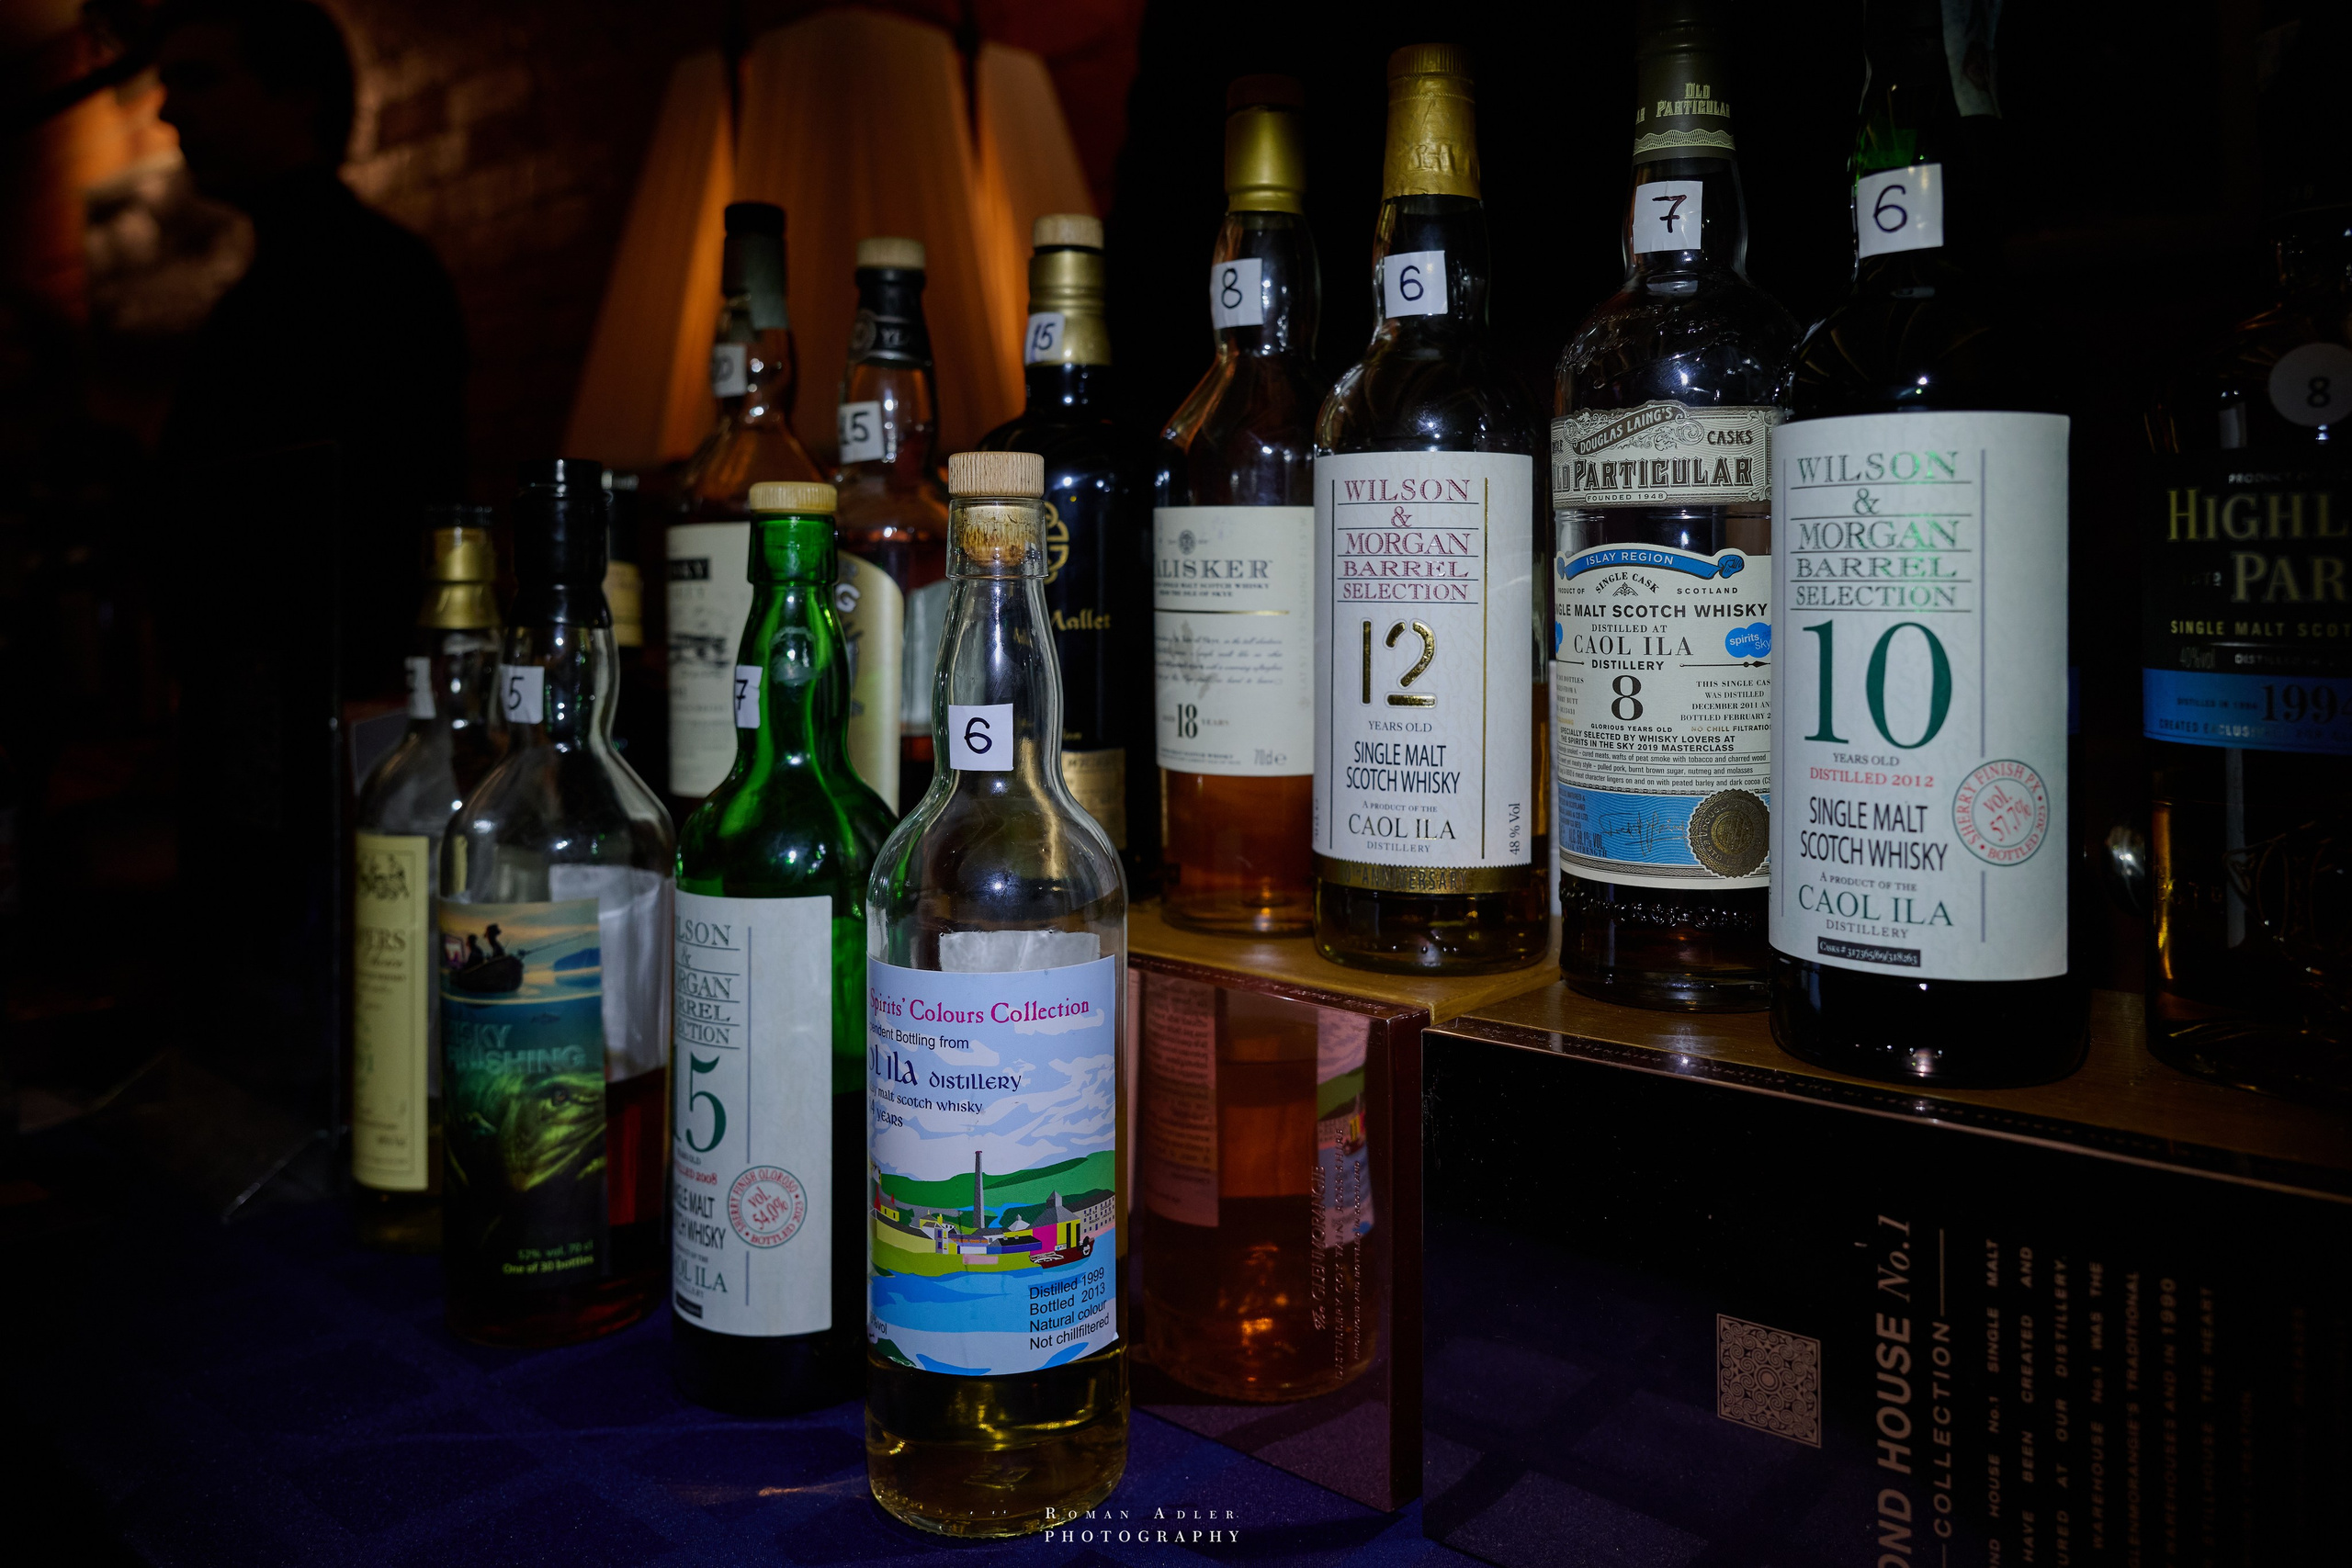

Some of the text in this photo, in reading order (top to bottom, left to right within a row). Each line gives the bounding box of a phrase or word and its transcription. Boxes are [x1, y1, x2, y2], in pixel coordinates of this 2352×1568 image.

[1684, 82, 1711, 99] OLD
[1656, 99, 1731, 118] PARTICULAR
[1652, 194, 1687, 233] 7
[1872, 185, 1907, 233] 6
[1221, 267, 1243, 309] 8
[1399, 265, 1423, 301] 6
[1032, 322, 1056, 350] 15
[2307, 377, 2329, 408] 8
[1579, 424, 1623, 455] DOUGLAS
[1626, 406, 1672, 434] LAING'S
[1707, 430, 1753, 446] CASKS
[1573, 456, 1754, 492] PARTICULAR
[1796, 451, 1959, 484] WILSON
[1344, 479, 1470, 502] WILSON
[1852, 488, 1880, 515] &
[1390, 506, 1412, 528] &
[2165, 486, 2349, 543] HIGHL
[1345, 532, 1471, 555] MORGAN
[1798, 520, 1960, 550] MORGAN
[1343, 560, 1469, 578] BARREL
[1586, 552, 1674, 566] ISLAY REGION
[1796, 557, 1958, 578] BARREL
[1595, 571, 1660, 594] SINGLE CASK
[2230, 551, 2348, 604] PAR
[1342, 582, 1468, 601] SELECTION
[1795, 585, 1957, 607] SELECTION
[1574, 603, 1768, 618] MALT SCOTCH WHISKY
[1591, 624, 1647, 633] DISTILLED
[1729, 633, 1759, 647] spirits
[2170, 619, 2286, 637] SINGLE MALT
[1574, 635, 1693, 656] CAOL ILA
[1363, 620, 1436, 706] 12
[1591, 660, 1665, 671] DISTILLERY
[509, 676, 525, 710] 5
[736, 680, 749, 711] 7
[1611, 674, 1644, 721] 8
[1803, 619, 1952, 750] 10
[1680, 713, 1765, 722] BOTTLED FEBRUARY
[1691, 702, 1738, 710] DECEMBER
[964, 716, 992, 754] 6
[1177, 704, 1197, 739] 18
[1368, 720, 1432, 733] YEARS OLD
[1568, 737, 1588, 746] SPIRITS
[1584, 731, 1623, 740] SELECTED
[1639, 735, 1678, 743] WHISKY
[1354, 740, 1446, 767] SINGLE MALT
[1635, 755, 1648, 763] peat
[1728, 754, 1750, 762] charred
[1832, 752, 1900, 767] YEARS OLD
[1346, 767, 1460, 794] SCOTCH WHISKY
[1810, 767, 1935, 788] DISTILLED 2012
[1809, 795, 1928, 833] SINGLE MALT
[1957, 762, 2041, 845] SHERRY FINISH PX
[1349, 814, 1408, 839] CAOL
[1416, 818, 1456, 840] ILA
[1509, 802, 1521, 855] 48 Vol
[1367, 840, 1430, 853] DISTILLERY
[1801, 829, 1949, 872] SCOTCH WHISKY
[1987, 833, 2040, 861] BOTTLED
[1362, 868, 1468, 891] ANNIVERSARY
[1798, 884, 1954, 927] CAOL ILA
[1826, 919, 1908, 939] DISTILLERY
[910, 999, 984, 1024] Colours
[991, 998, 1090, 1023] Collection
[896, 1030, 969, 1050] Bottling from
[877, 1088, 983, 1114] malt scotch whisky
[732, 1168, 798, 1196] FINISH OLOROSO
[688, 1217, 726, 1250] WHISKY
[751, 1224, 795, 1245] BOTTLED
[1310, 1165, 1326, 1302] GLENMORANGIE
[503, 1263, 526, 1274] One
[526, 1262, 538, 1273] of
[555, 1255, 594, 1271] bottles
[695, 1266, 728, 1293] ILA
[1030, 1267, 1104, 1300] Distilled 1999
[1030, 1282, 1105, 1315] Bottled 2013
[1030, 1301, 1107, 1333] Natural colour
[1030, 1313, 1110, 1350] Not chillfiltered
[1334, 1298, 1344, 1381] DISTILLERY
[1875, 1213, 1914, 1476] HOUSE No.1
[1985, 1237, 2001, 1518] HOUSE SINGLE MALT
[2019, 1246, 2035, 1562] HAVE BEEN CREATED AND
[1931, 1320, 1953, 1540] COLLECTION
